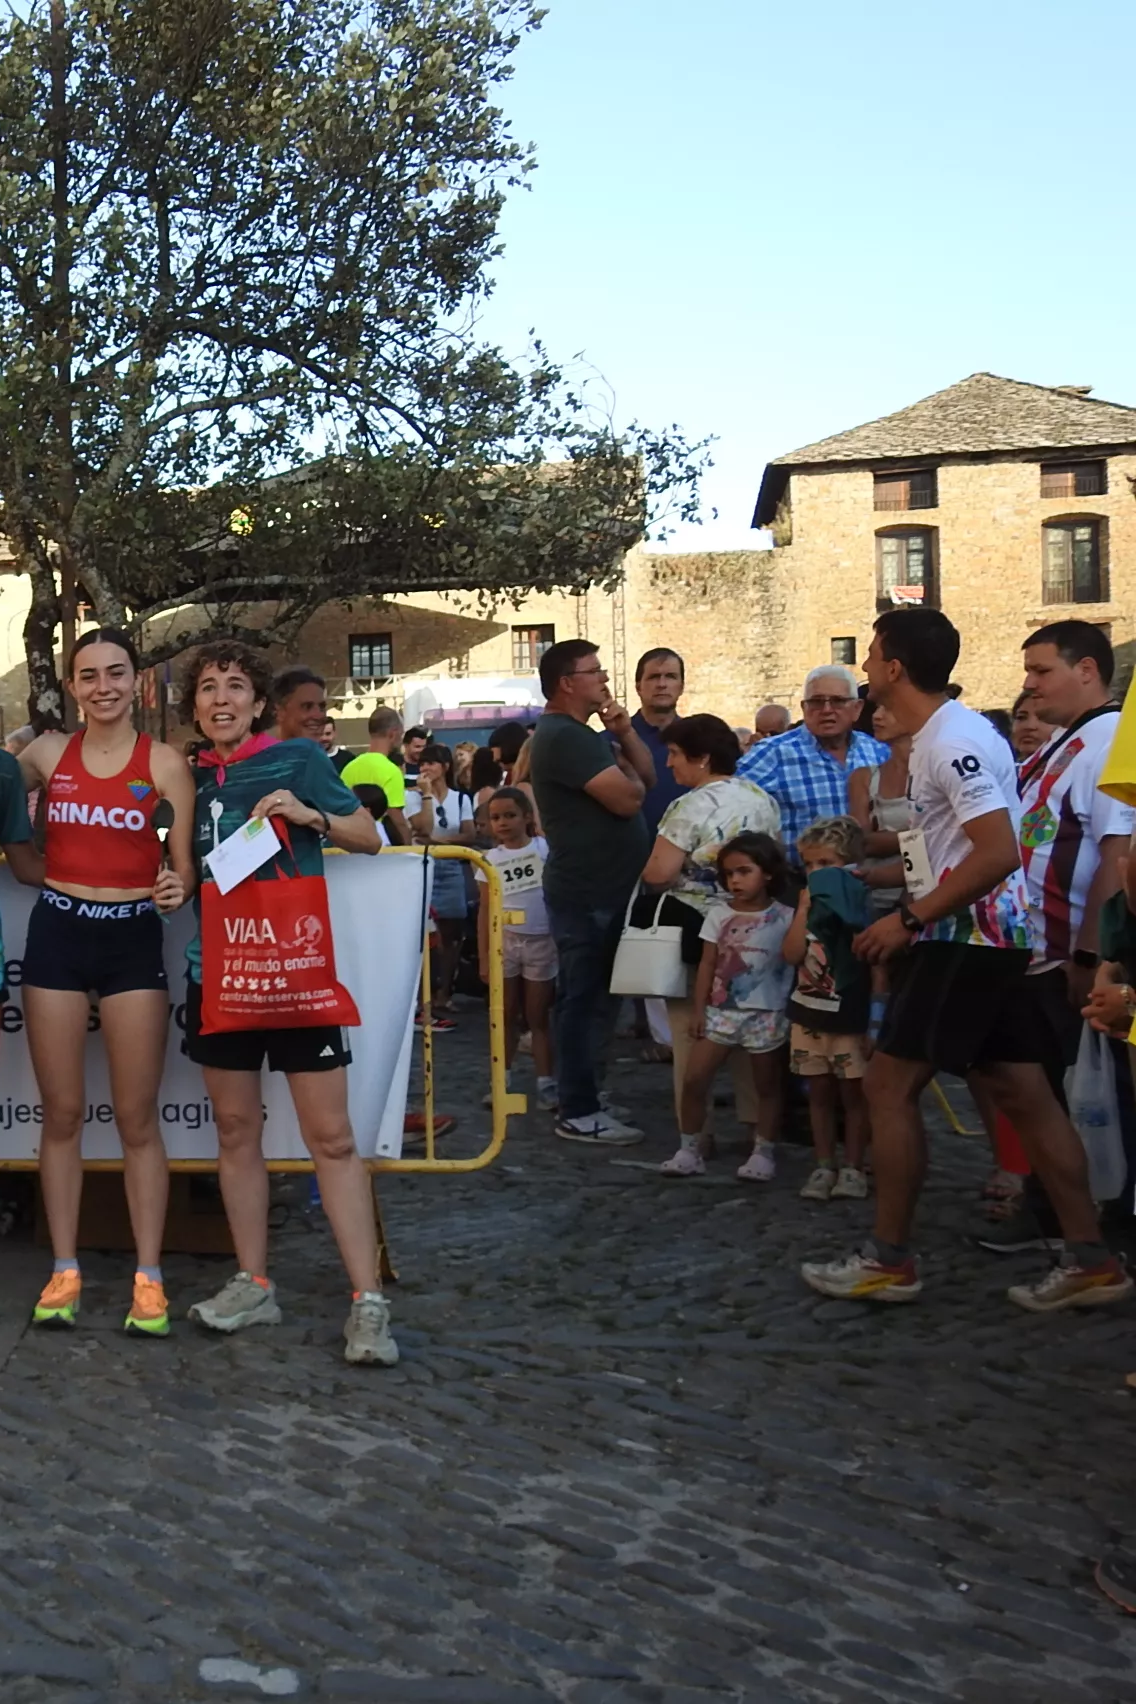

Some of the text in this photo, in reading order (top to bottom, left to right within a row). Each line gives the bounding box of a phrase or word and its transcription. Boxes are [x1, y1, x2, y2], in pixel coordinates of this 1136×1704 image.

[951, 755, 981, 777] 10
[48, 802, 146, 832] HINACO
[503, 864, 534, 882] 196
[77, 903, 133, 919] NIKE
[223, 958, 231, 973] y
[232, 957, 243, 971] el
[284, 955, 325, 971] enorme
[219, 988, 334, 1003] centraldereservas.com
[84, 1103, 114, 1124] ue
